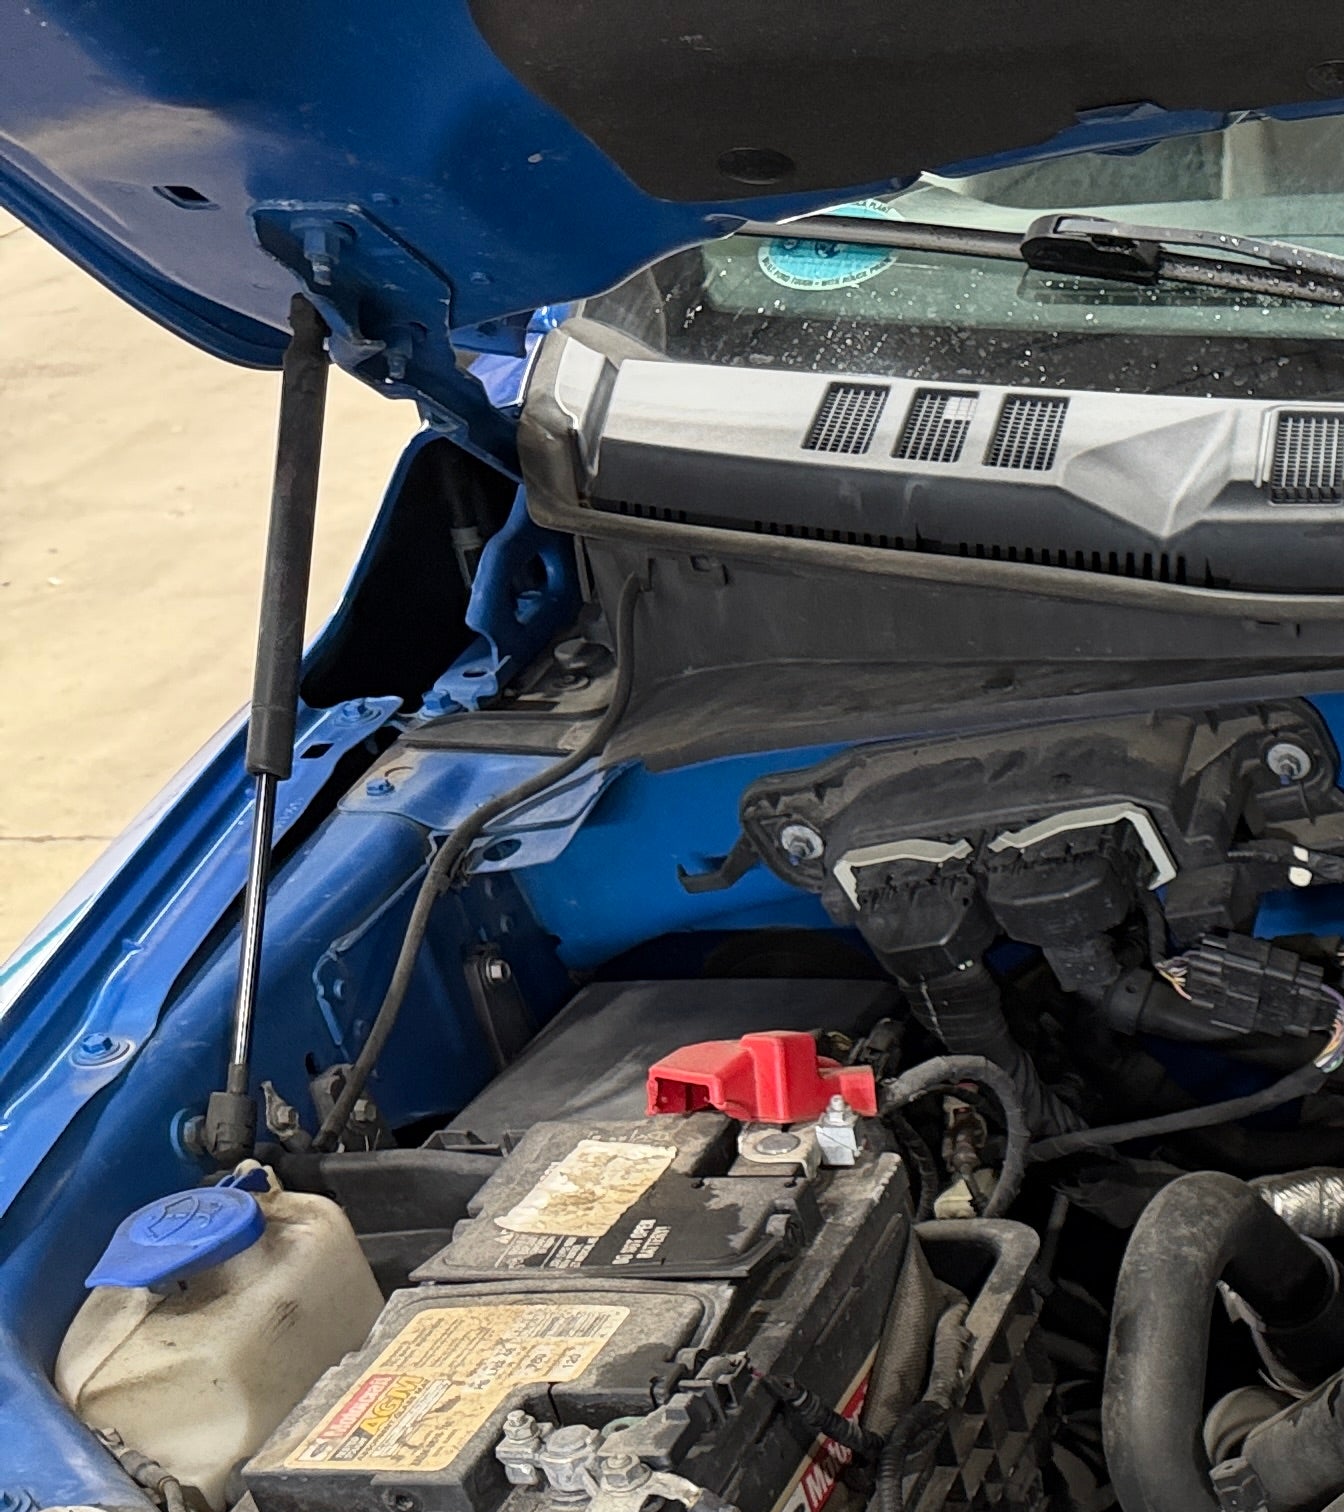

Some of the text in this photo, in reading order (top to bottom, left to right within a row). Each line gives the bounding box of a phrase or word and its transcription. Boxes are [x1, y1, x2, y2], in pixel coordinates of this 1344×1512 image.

[775, 271, 790, 283] FORD
[791, 277, 813, 287] TOUGH
[359, 1375, 425, 1434] AGM
